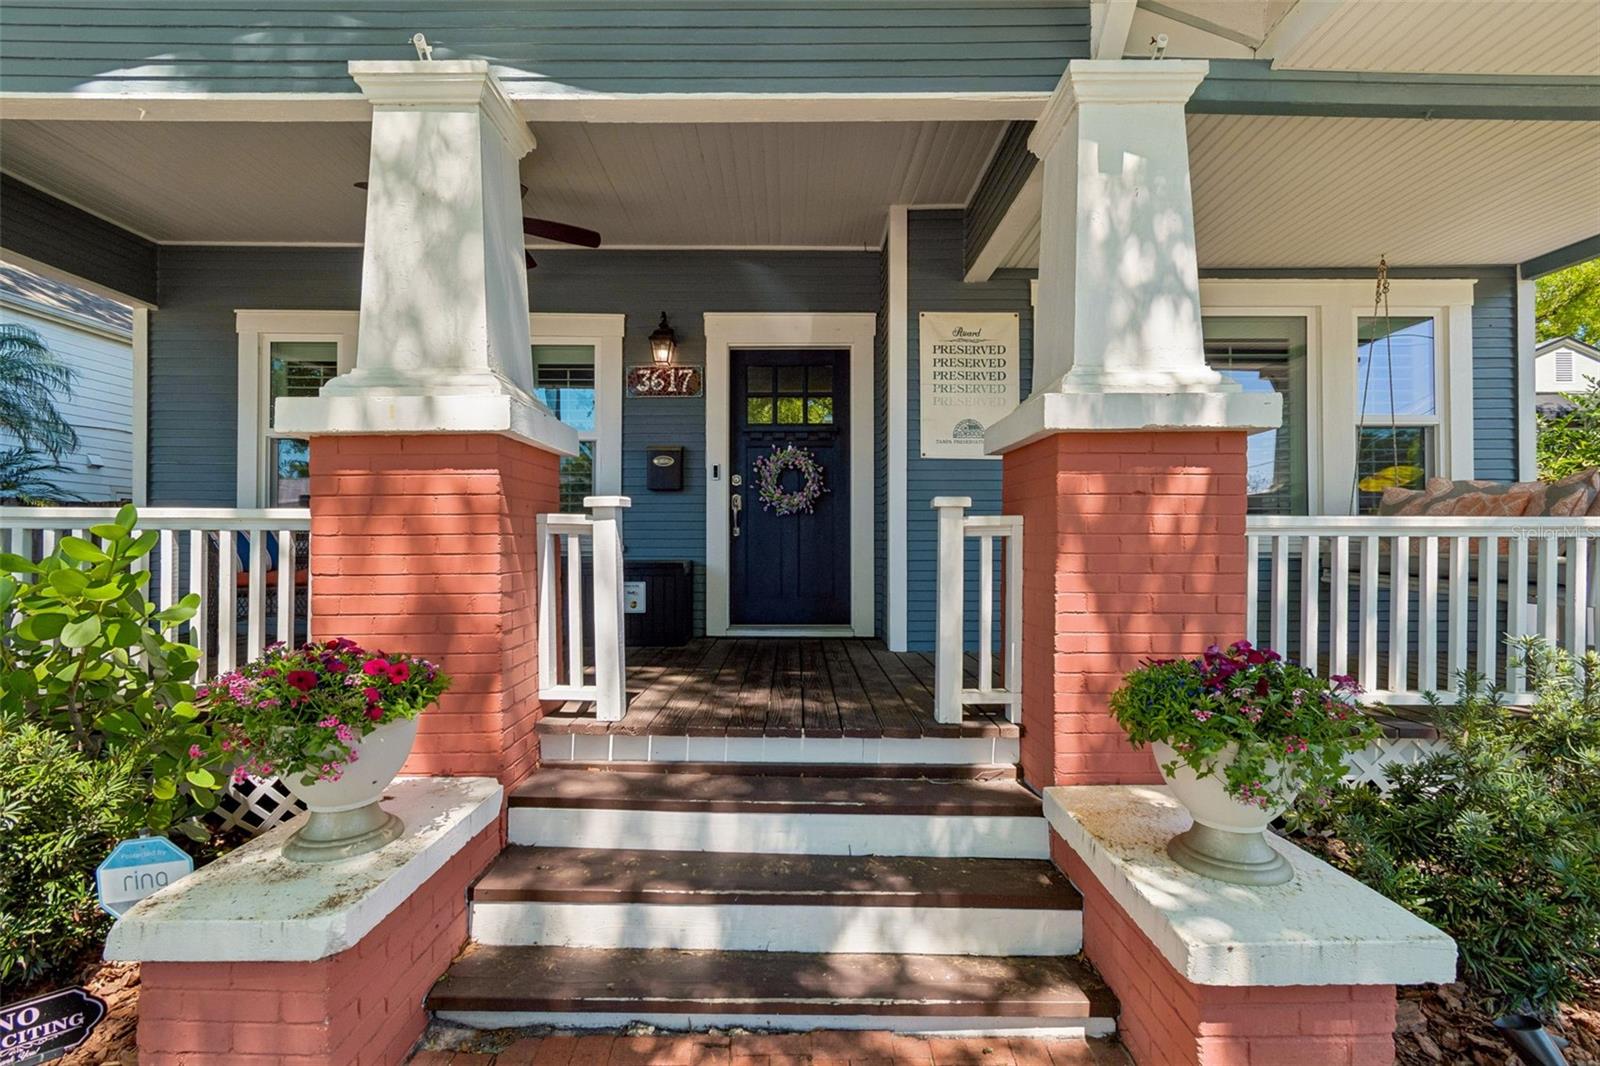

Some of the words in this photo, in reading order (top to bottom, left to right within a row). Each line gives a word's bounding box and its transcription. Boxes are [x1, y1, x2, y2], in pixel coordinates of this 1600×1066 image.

[952, 327, 982, 337] Award
[933, 345, 1006, 355] PRESERVED
[933, 358, 1006, 368] PRESERVED
[636, 369, 693, 392] 3617
[933, 371, 1006, 381] PRESERVED
[933, 384, 1006, 394] PRESERVED
[933, 397, 1006, 407] PRESERVED
[0, 1012, 85, 1048] CITING
